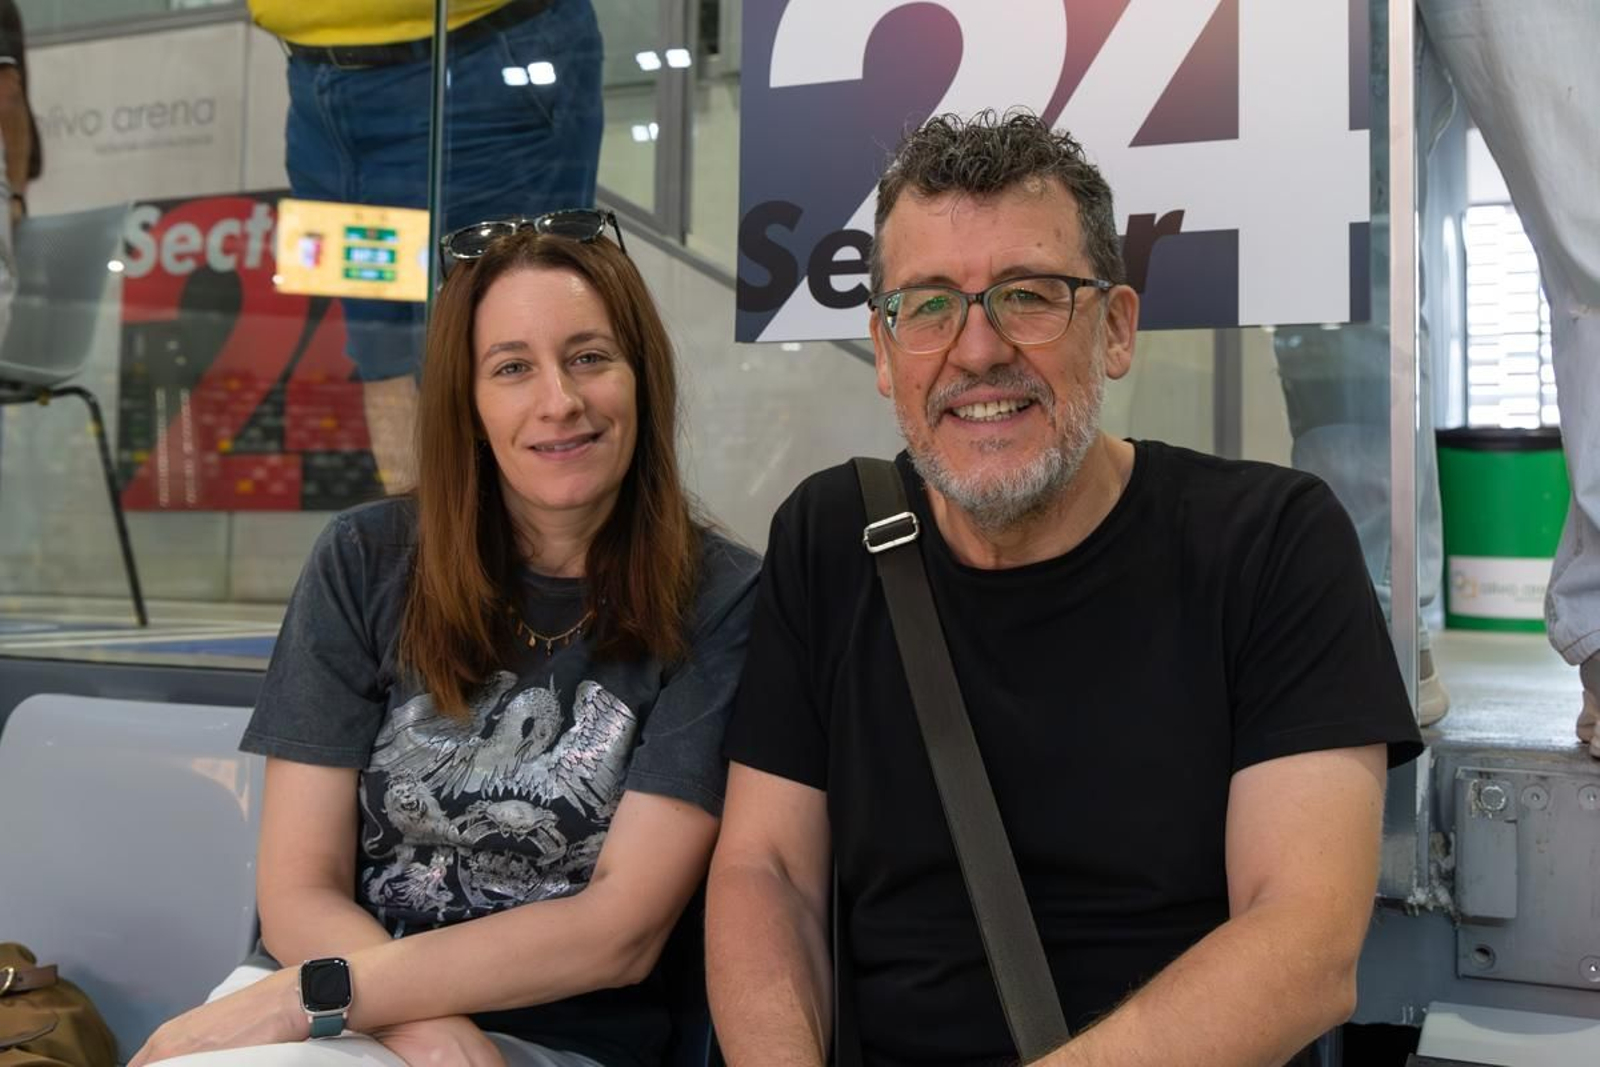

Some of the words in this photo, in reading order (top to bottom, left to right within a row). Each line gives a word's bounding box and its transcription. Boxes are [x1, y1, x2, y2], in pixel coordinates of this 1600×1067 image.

[111, 98, 214, 133] arena
[122, 203, 278, 278] Sect
[735, 200, 1186, 313] Ser
